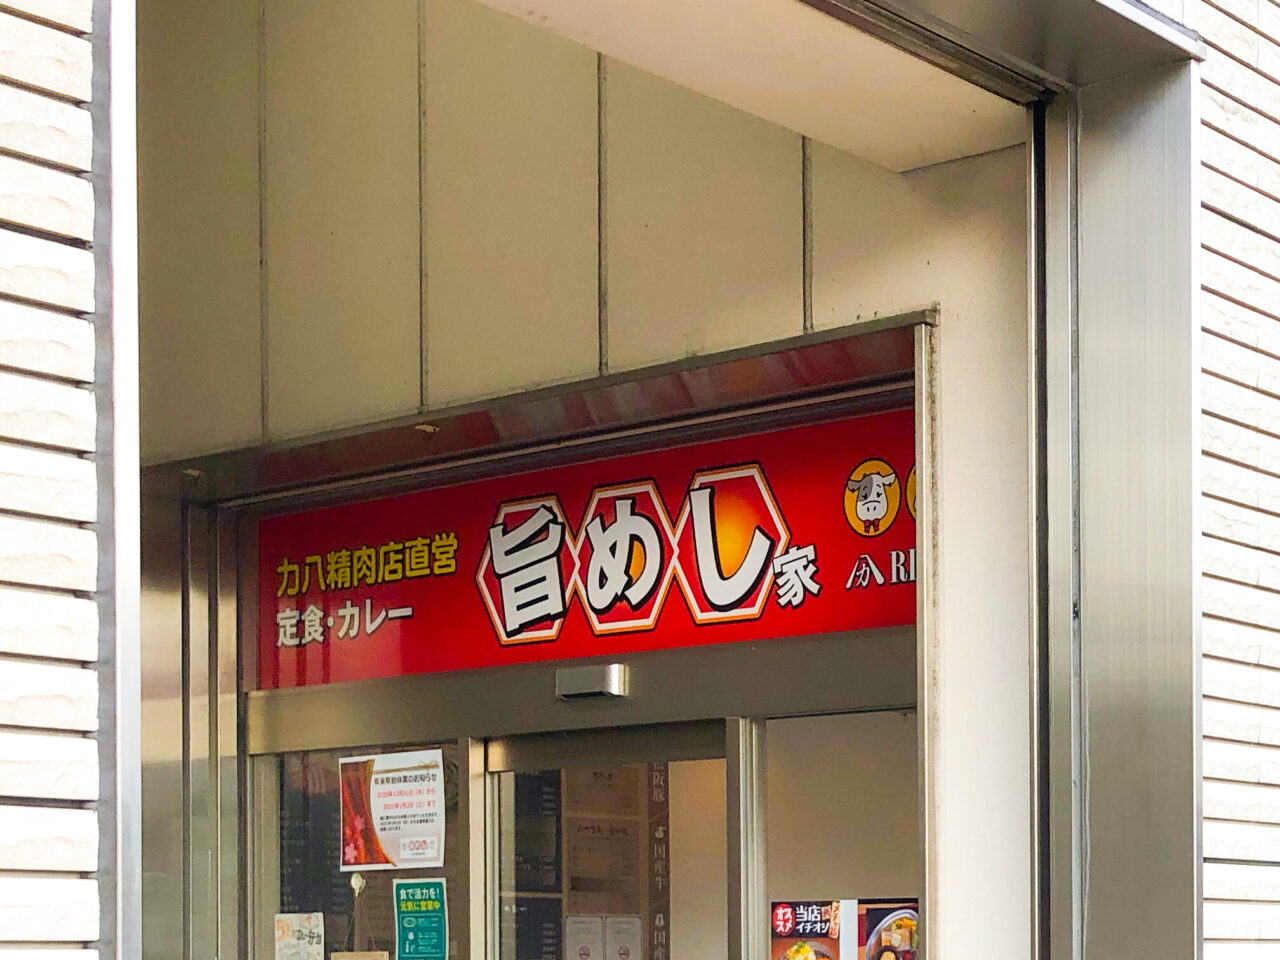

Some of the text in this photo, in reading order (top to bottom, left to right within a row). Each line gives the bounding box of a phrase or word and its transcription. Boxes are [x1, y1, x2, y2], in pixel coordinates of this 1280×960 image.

[490, 487, 822, 633] 旨めし家
[276, 598, 413, 648] 定食・カレー
[796, 904, 822, 922] 当店
